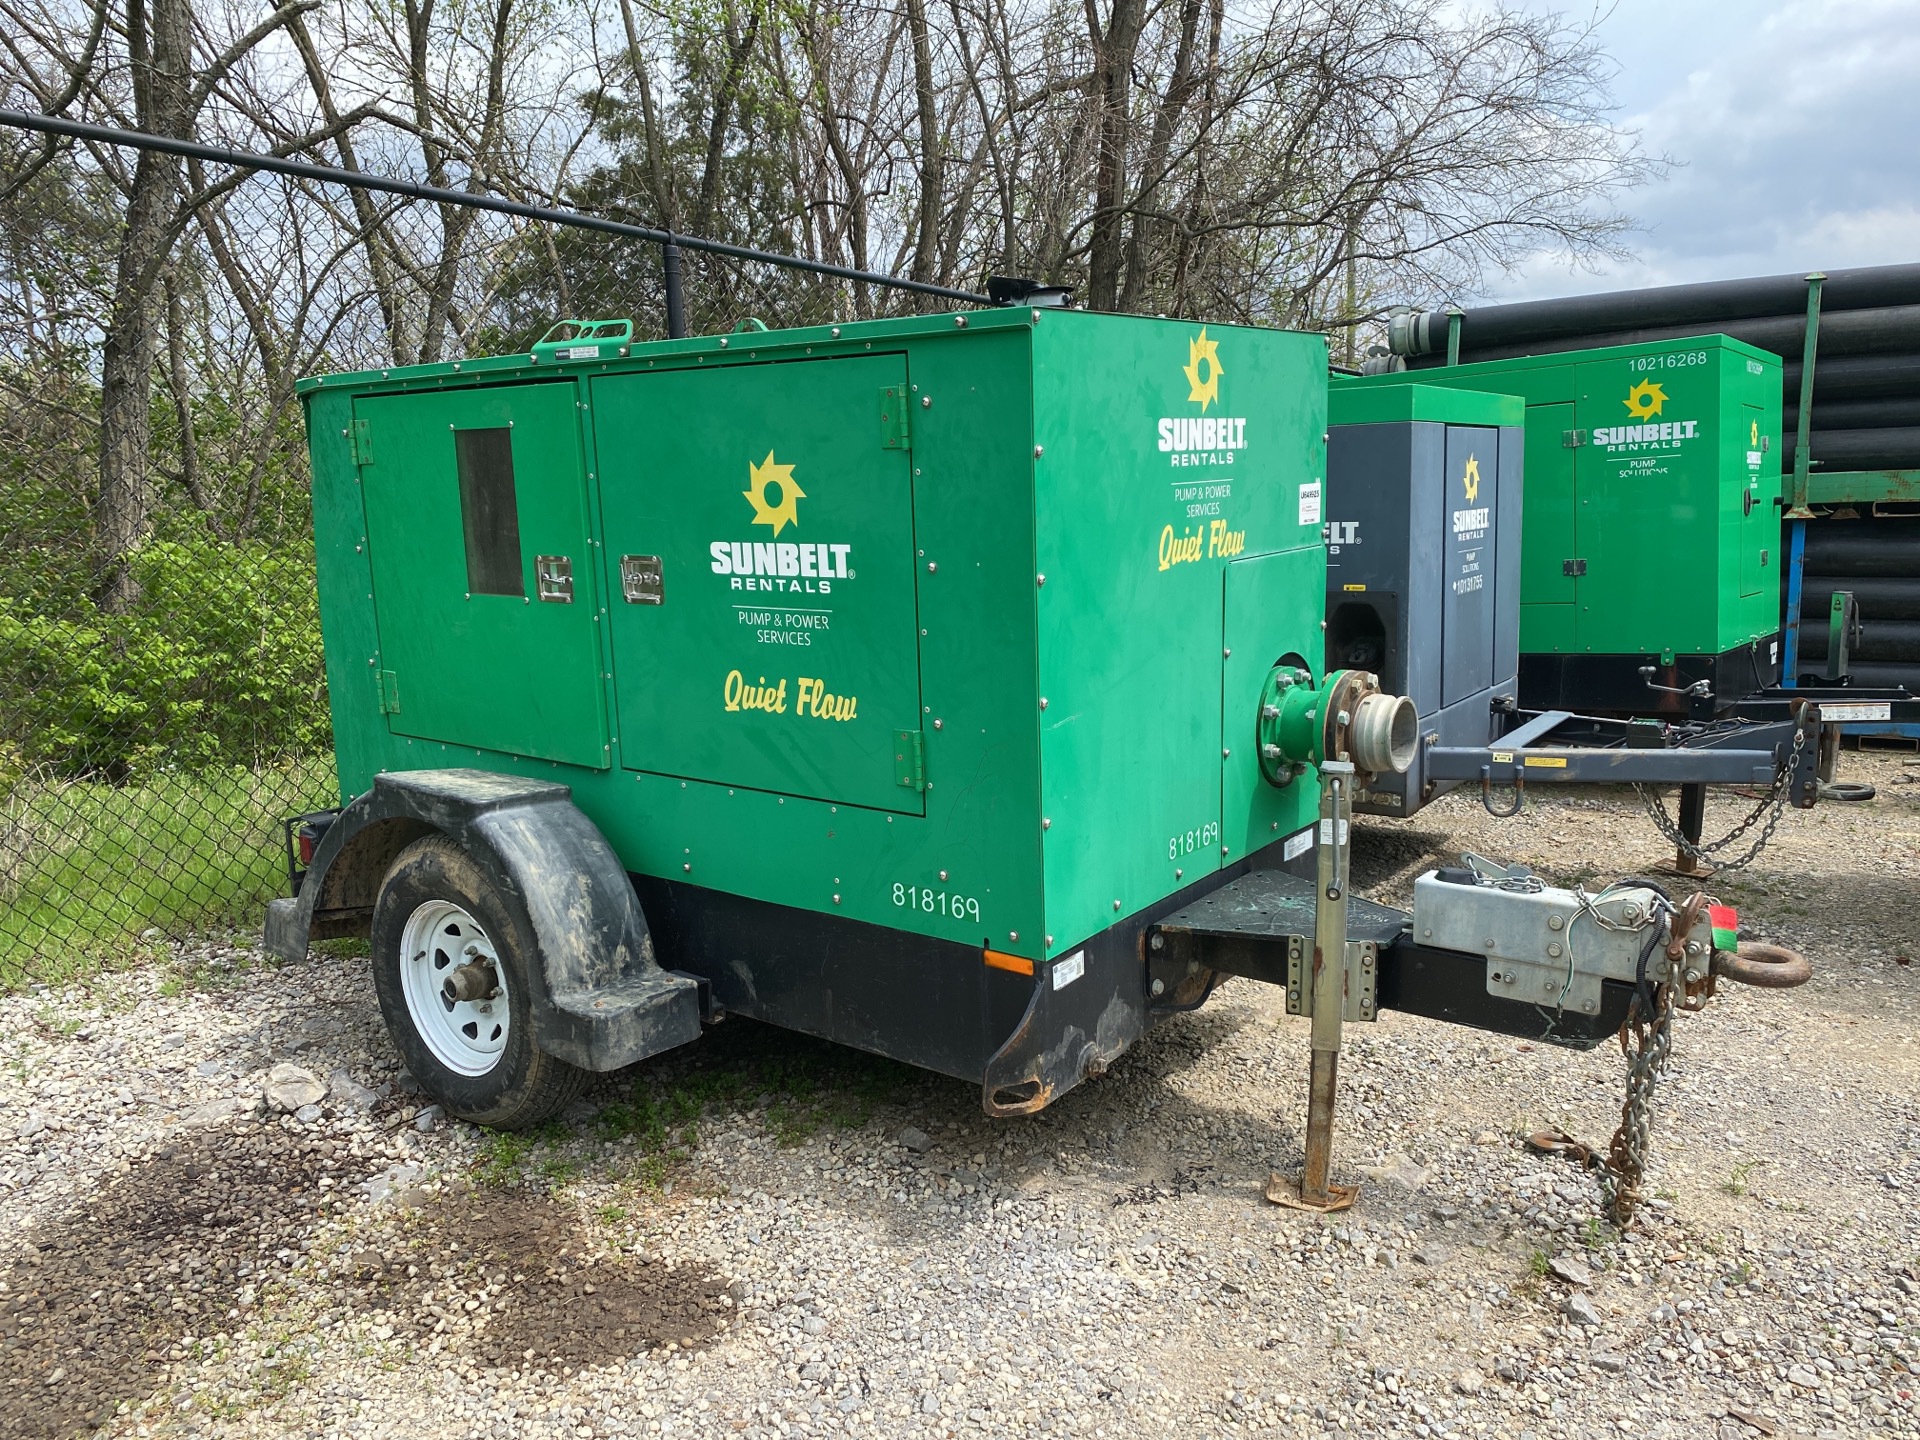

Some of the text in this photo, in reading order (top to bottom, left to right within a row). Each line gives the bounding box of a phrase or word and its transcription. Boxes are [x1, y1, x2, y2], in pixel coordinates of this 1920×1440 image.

[1628, 351, 1707, 372] 10216268
[1157, 417, 1247, 452] SUNBELT
[1592, 420, 1698, 446] SUNBELT
[1607, 440, 1682, 452] RENTALS
[1171, 452, 1234, 468] RENTALS
[1630, 459, 1657, 469] PUMP
[1174, 484, 1231, 501] PUMP & POWER
[1186, 501, 1220, 518] SERVICES
[1457, 529, 1484, 541] RENTALS
[1157, 518, 1245, 572] Quiet Flow
[709, 541, 851, 579] SUNBELT
[730, 577, 832, 594] RENTALS
[738, 611, 830, 630] PUMP & POWER
[756, 629, 811, 646] SERVICES
[724, 669, 858, 722] Quiet Flow
[1168, 821, 1219, 860] 818169
[892, 882, 980, 923] 818169
